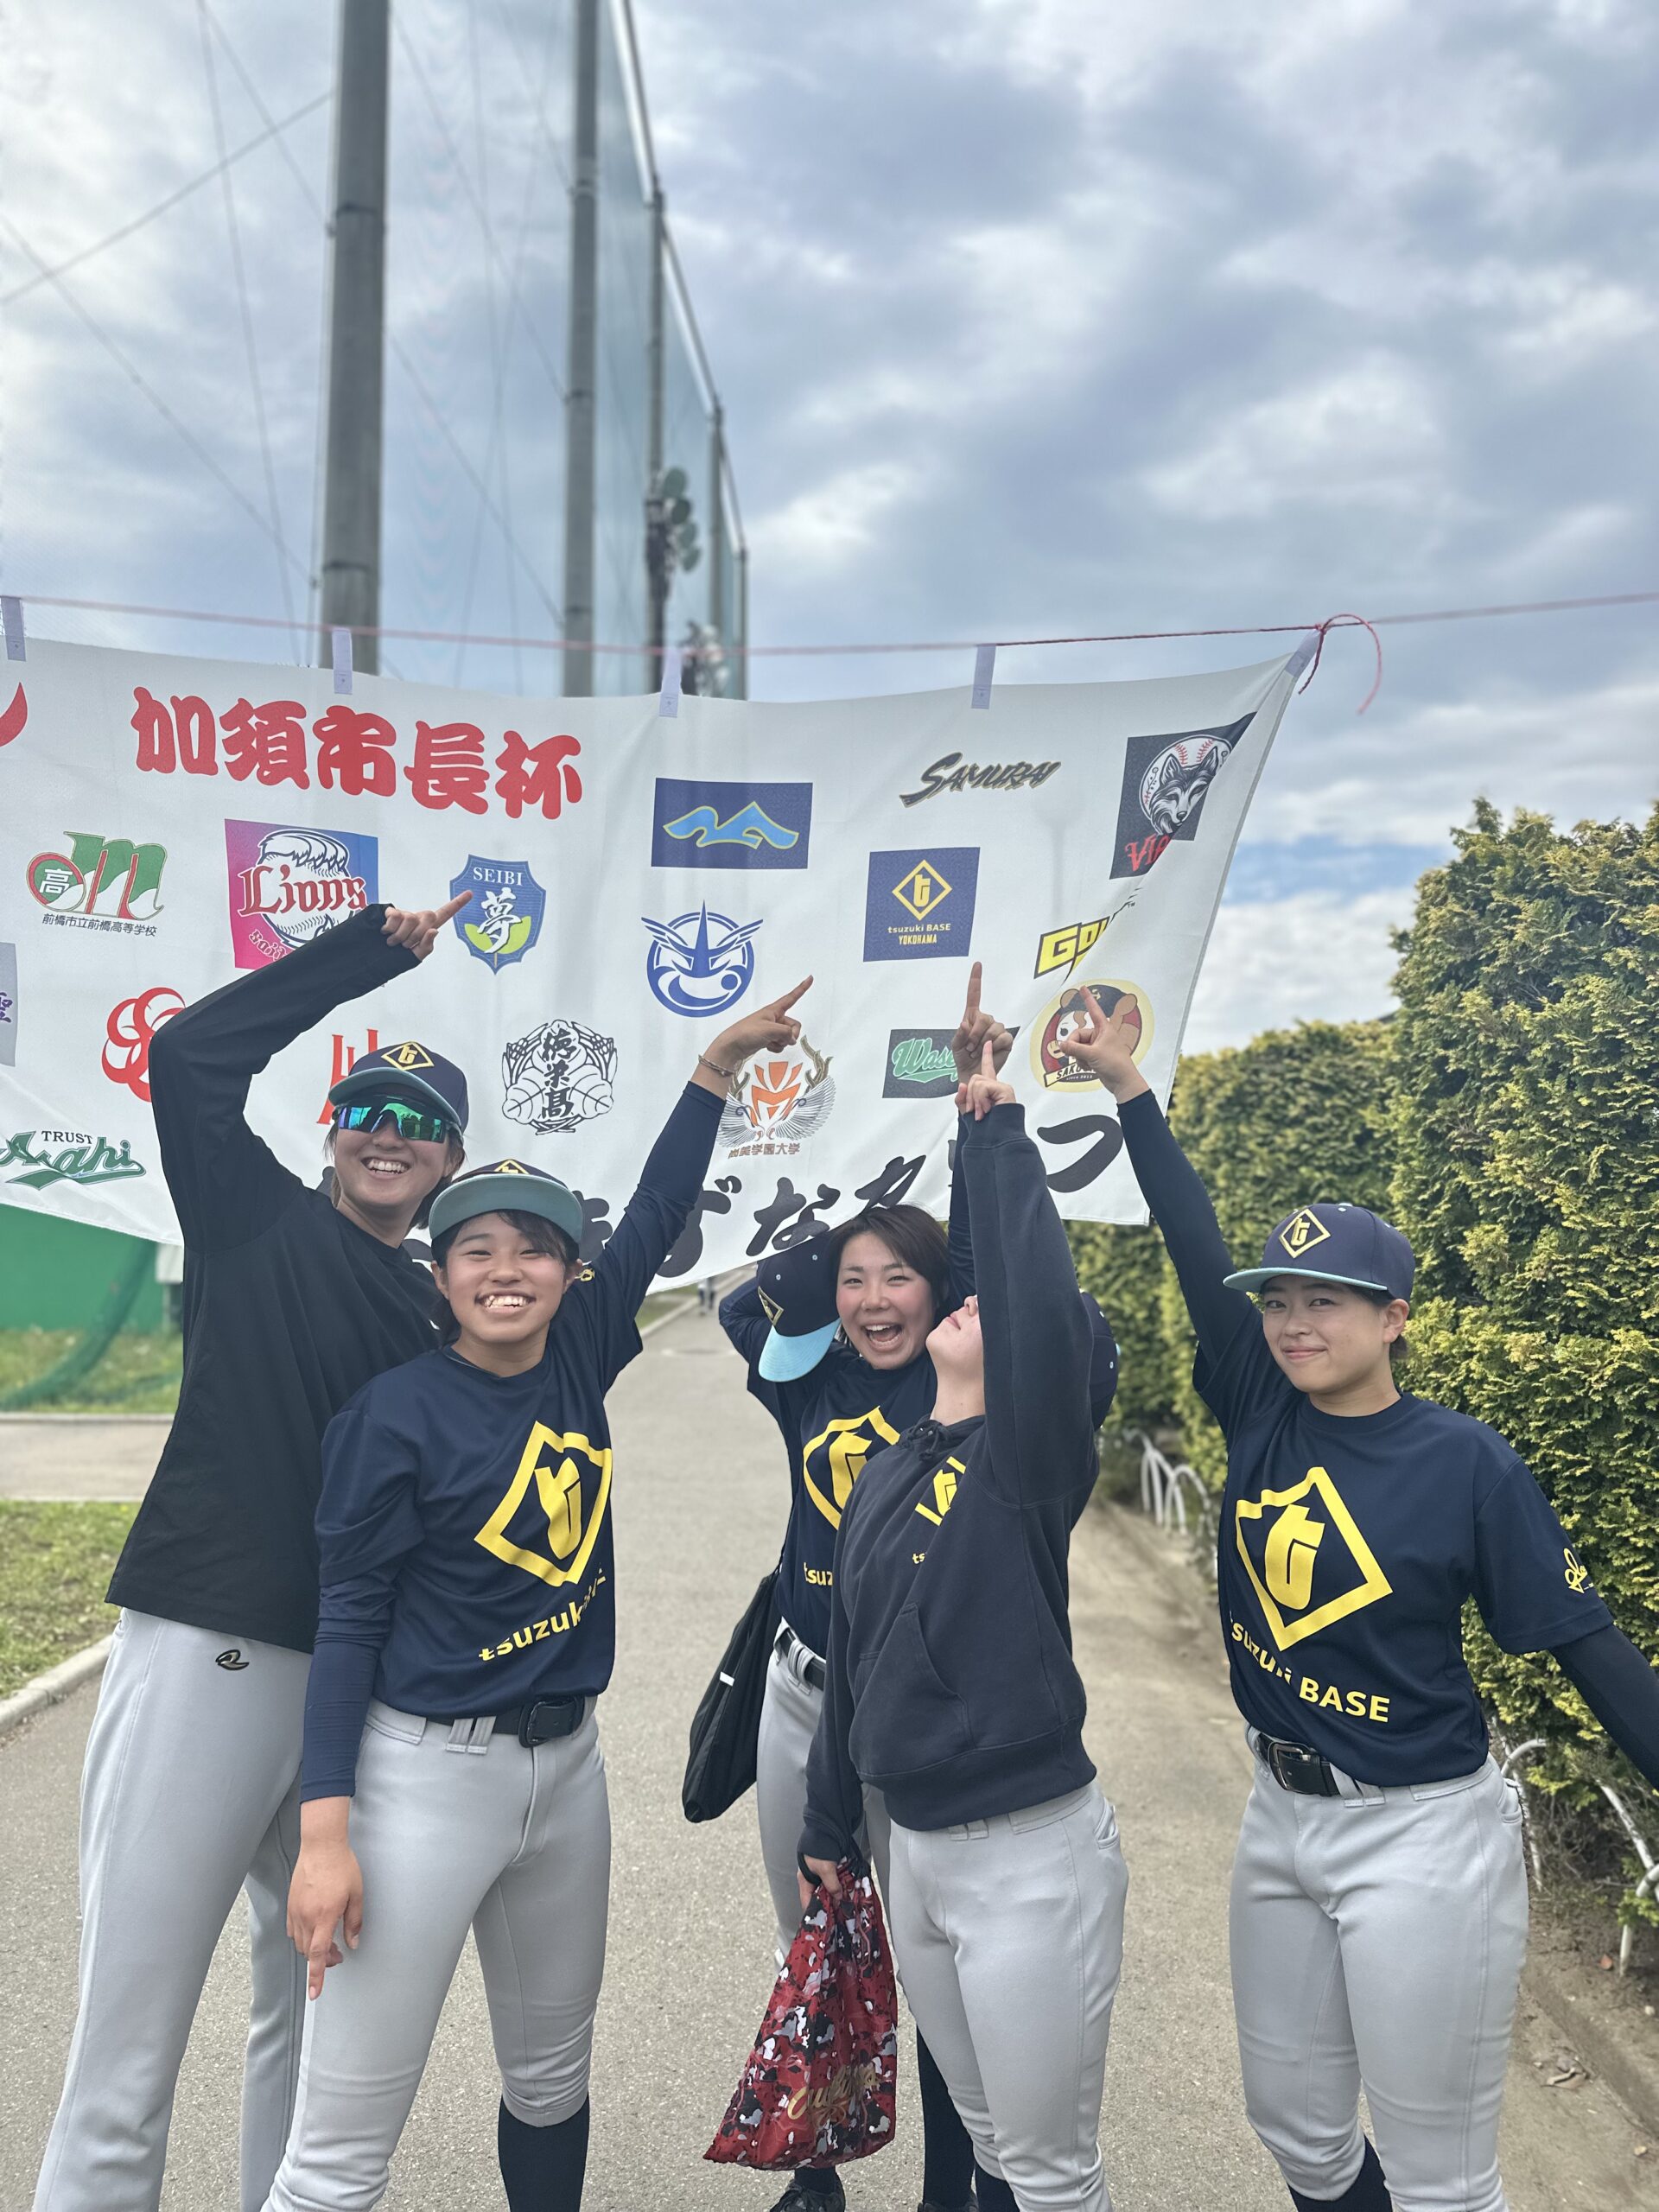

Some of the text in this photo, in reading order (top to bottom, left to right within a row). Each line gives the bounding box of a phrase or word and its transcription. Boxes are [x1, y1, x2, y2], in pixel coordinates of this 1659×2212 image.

[130, 686, 582, 820] 加須市長杯
[39, 868, 73, 893] 高
[237, 863, 368, 915] Lions
[473, 867, 524, 886] SEIBI
[41, 912, 157, 938] 前橋市立前橋高等学校
[476, 887, 523, 954] 夢
[887, 923, 951, 933] tsuzuki BASE
[899, 934, 938, 945] YOKOHAMA
[892, 1038, 958, 1077] Wase
[41, 1130, 92, 1145] TRUST
[728, 1143, 800, 1160] 尚美学園大学
[478, 1597, 588, 1662] tsuzuk
[1299, 1676, 1390, 1723] BASE
